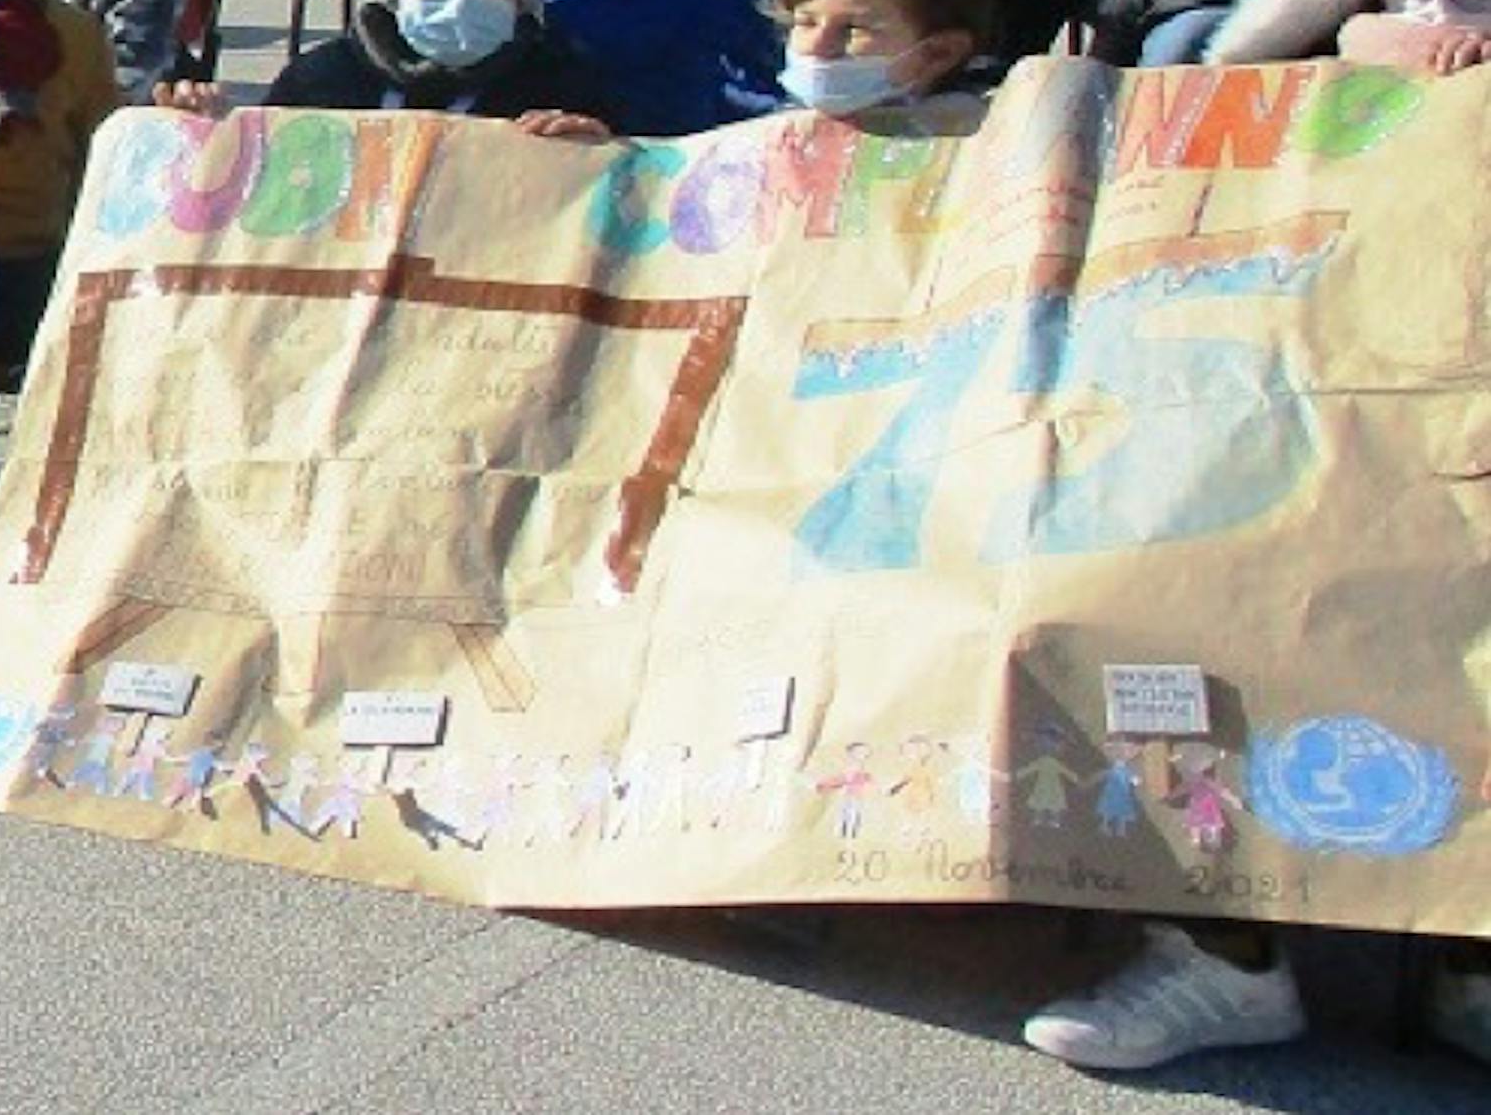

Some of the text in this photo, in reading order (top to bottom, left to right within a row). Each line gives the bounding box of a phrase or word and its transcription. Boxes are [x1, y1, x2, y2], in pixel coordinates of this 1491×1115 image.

[790, 211, 1350, 574] 75
[833, 840, 1313, 905] 20 Novembre 2021
